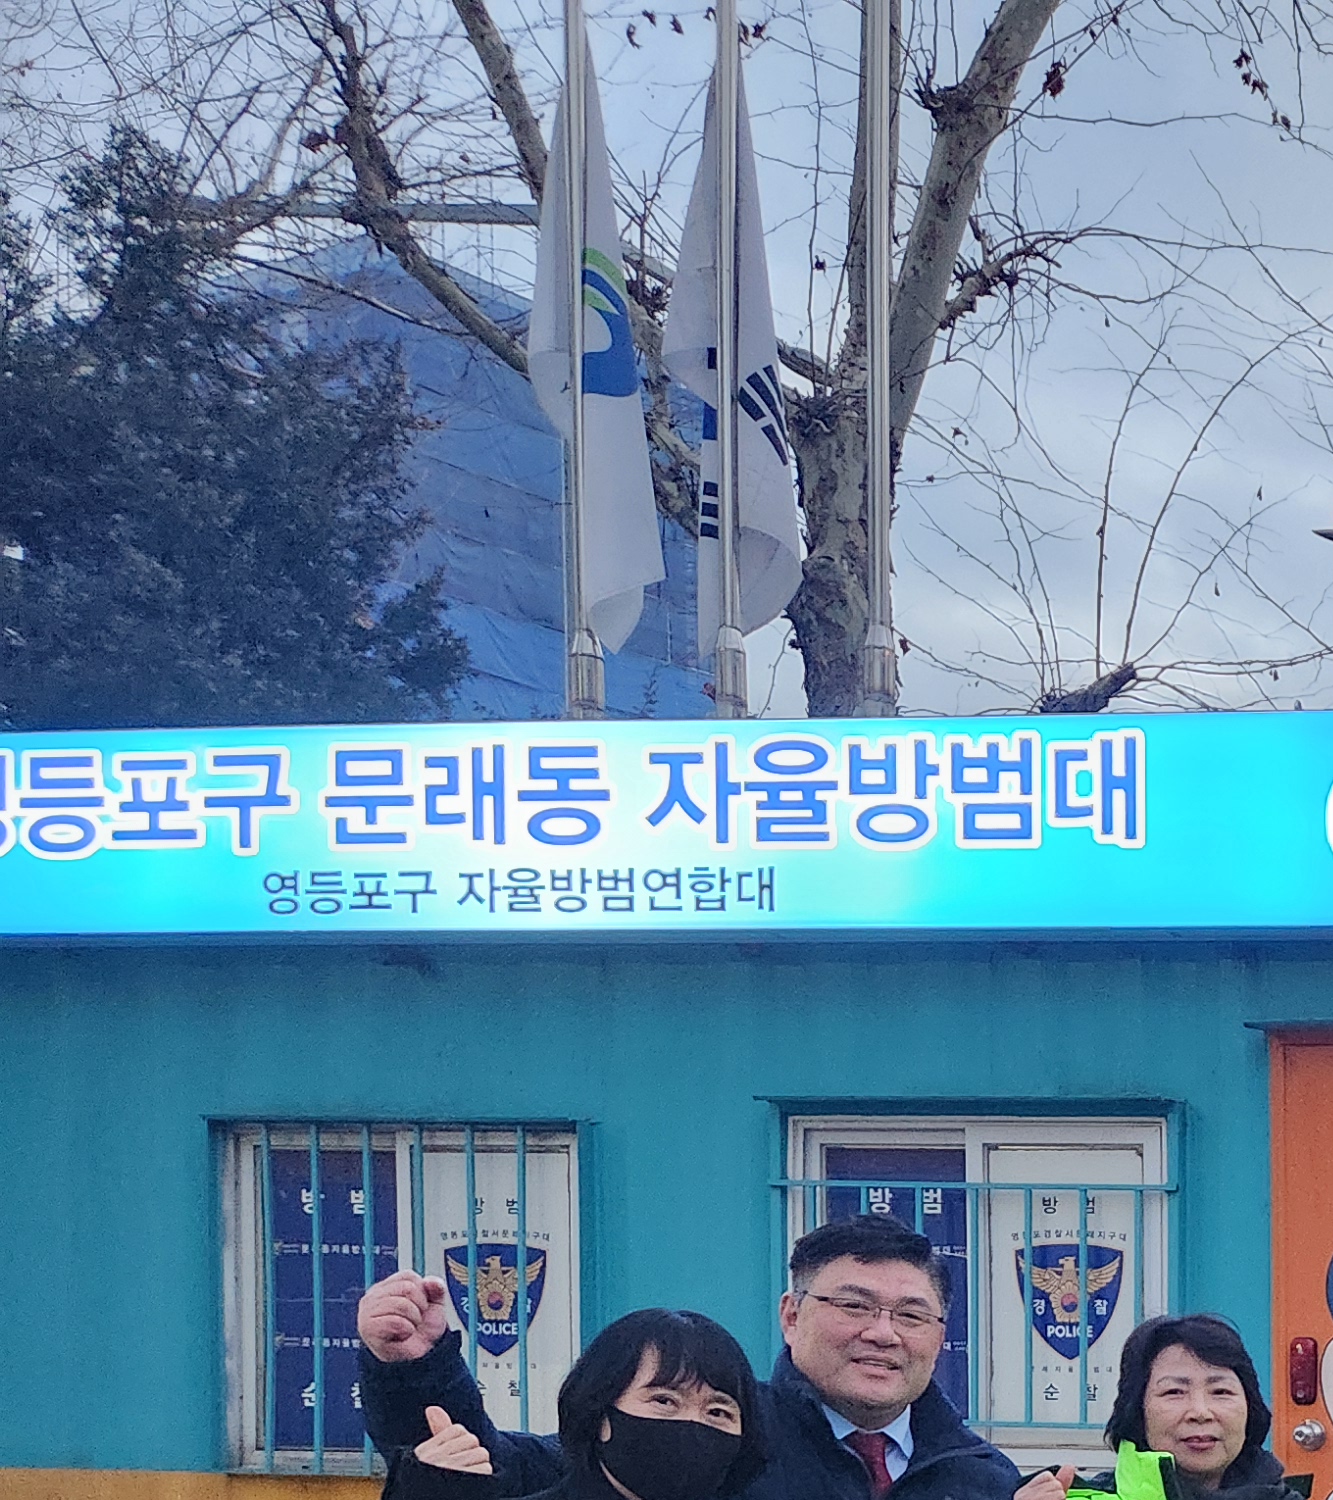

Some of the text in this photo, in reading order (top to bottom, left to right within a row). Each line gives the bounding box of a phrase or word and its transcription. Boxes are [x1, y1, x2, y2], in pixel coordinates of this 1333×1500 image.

[323, 739, 613, 849] 문래동
[643, 733, 1141, 847] 자율방범대
[261, 864, 778, 917] 영등포구 자율방범연합대
